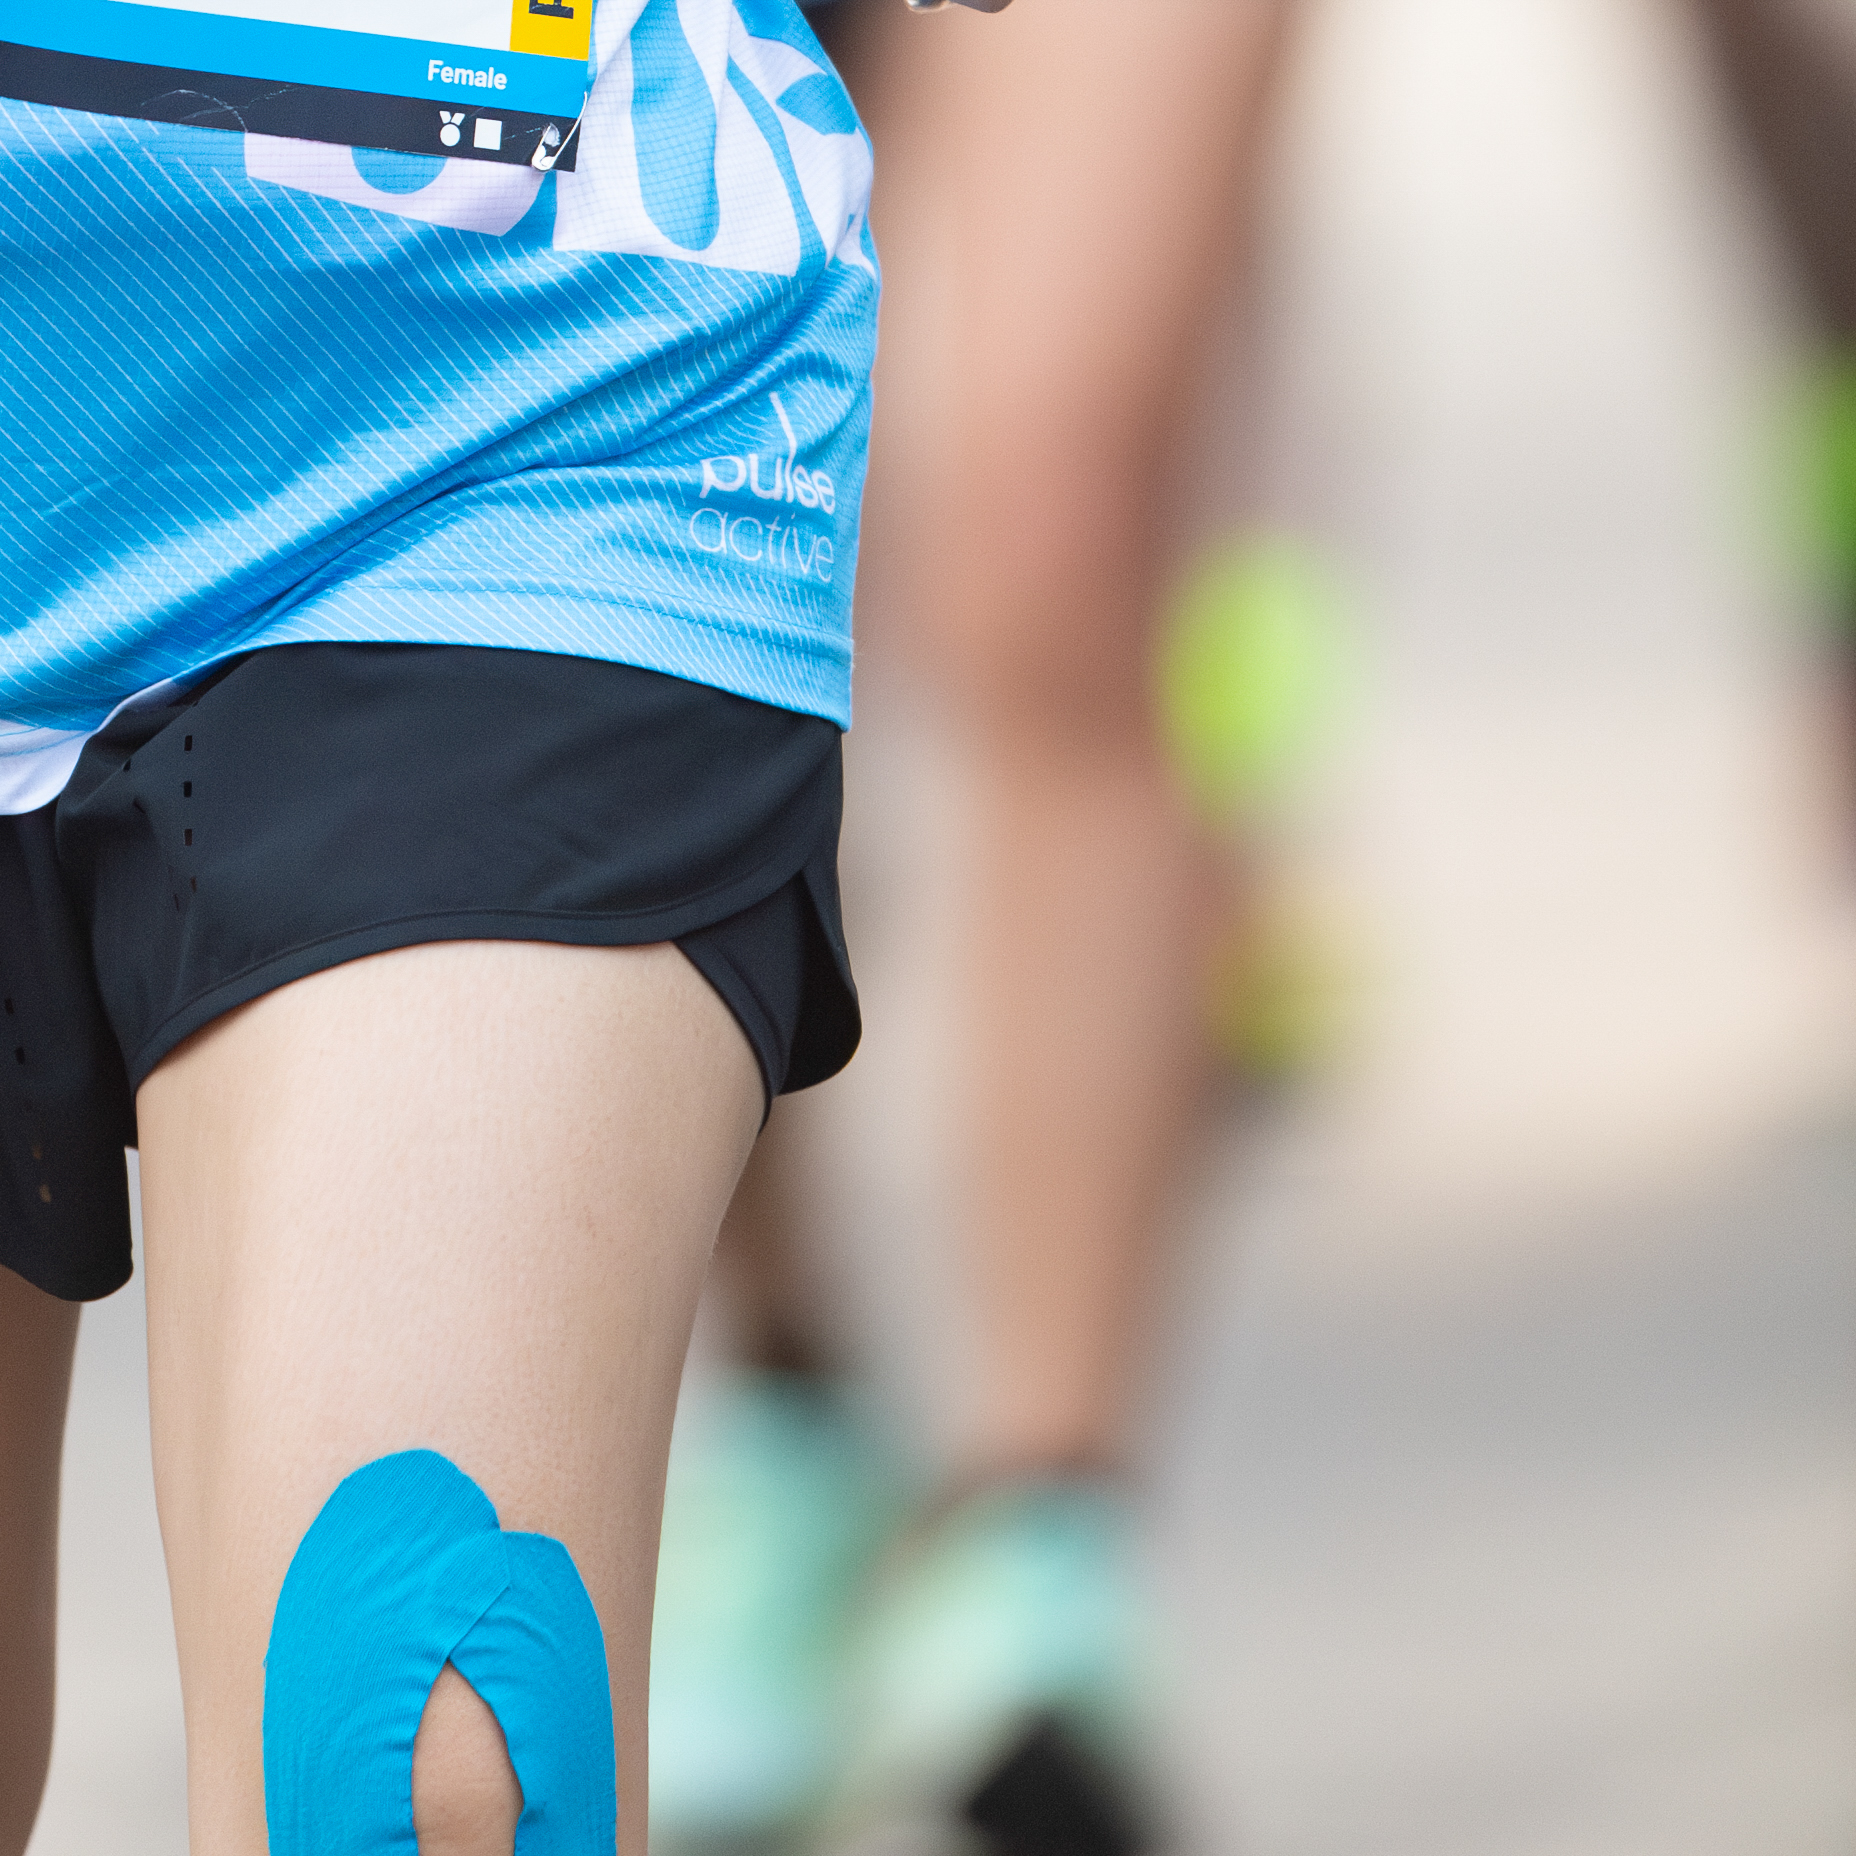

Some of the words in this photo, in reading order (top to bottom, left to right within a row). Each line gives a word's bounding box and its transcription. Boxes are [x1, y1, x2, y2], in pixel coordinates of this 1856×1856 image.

[427, 59, 507, 91] Female
[699, 391, 836, 514] pulse
[690, 508, 834, 582] active
